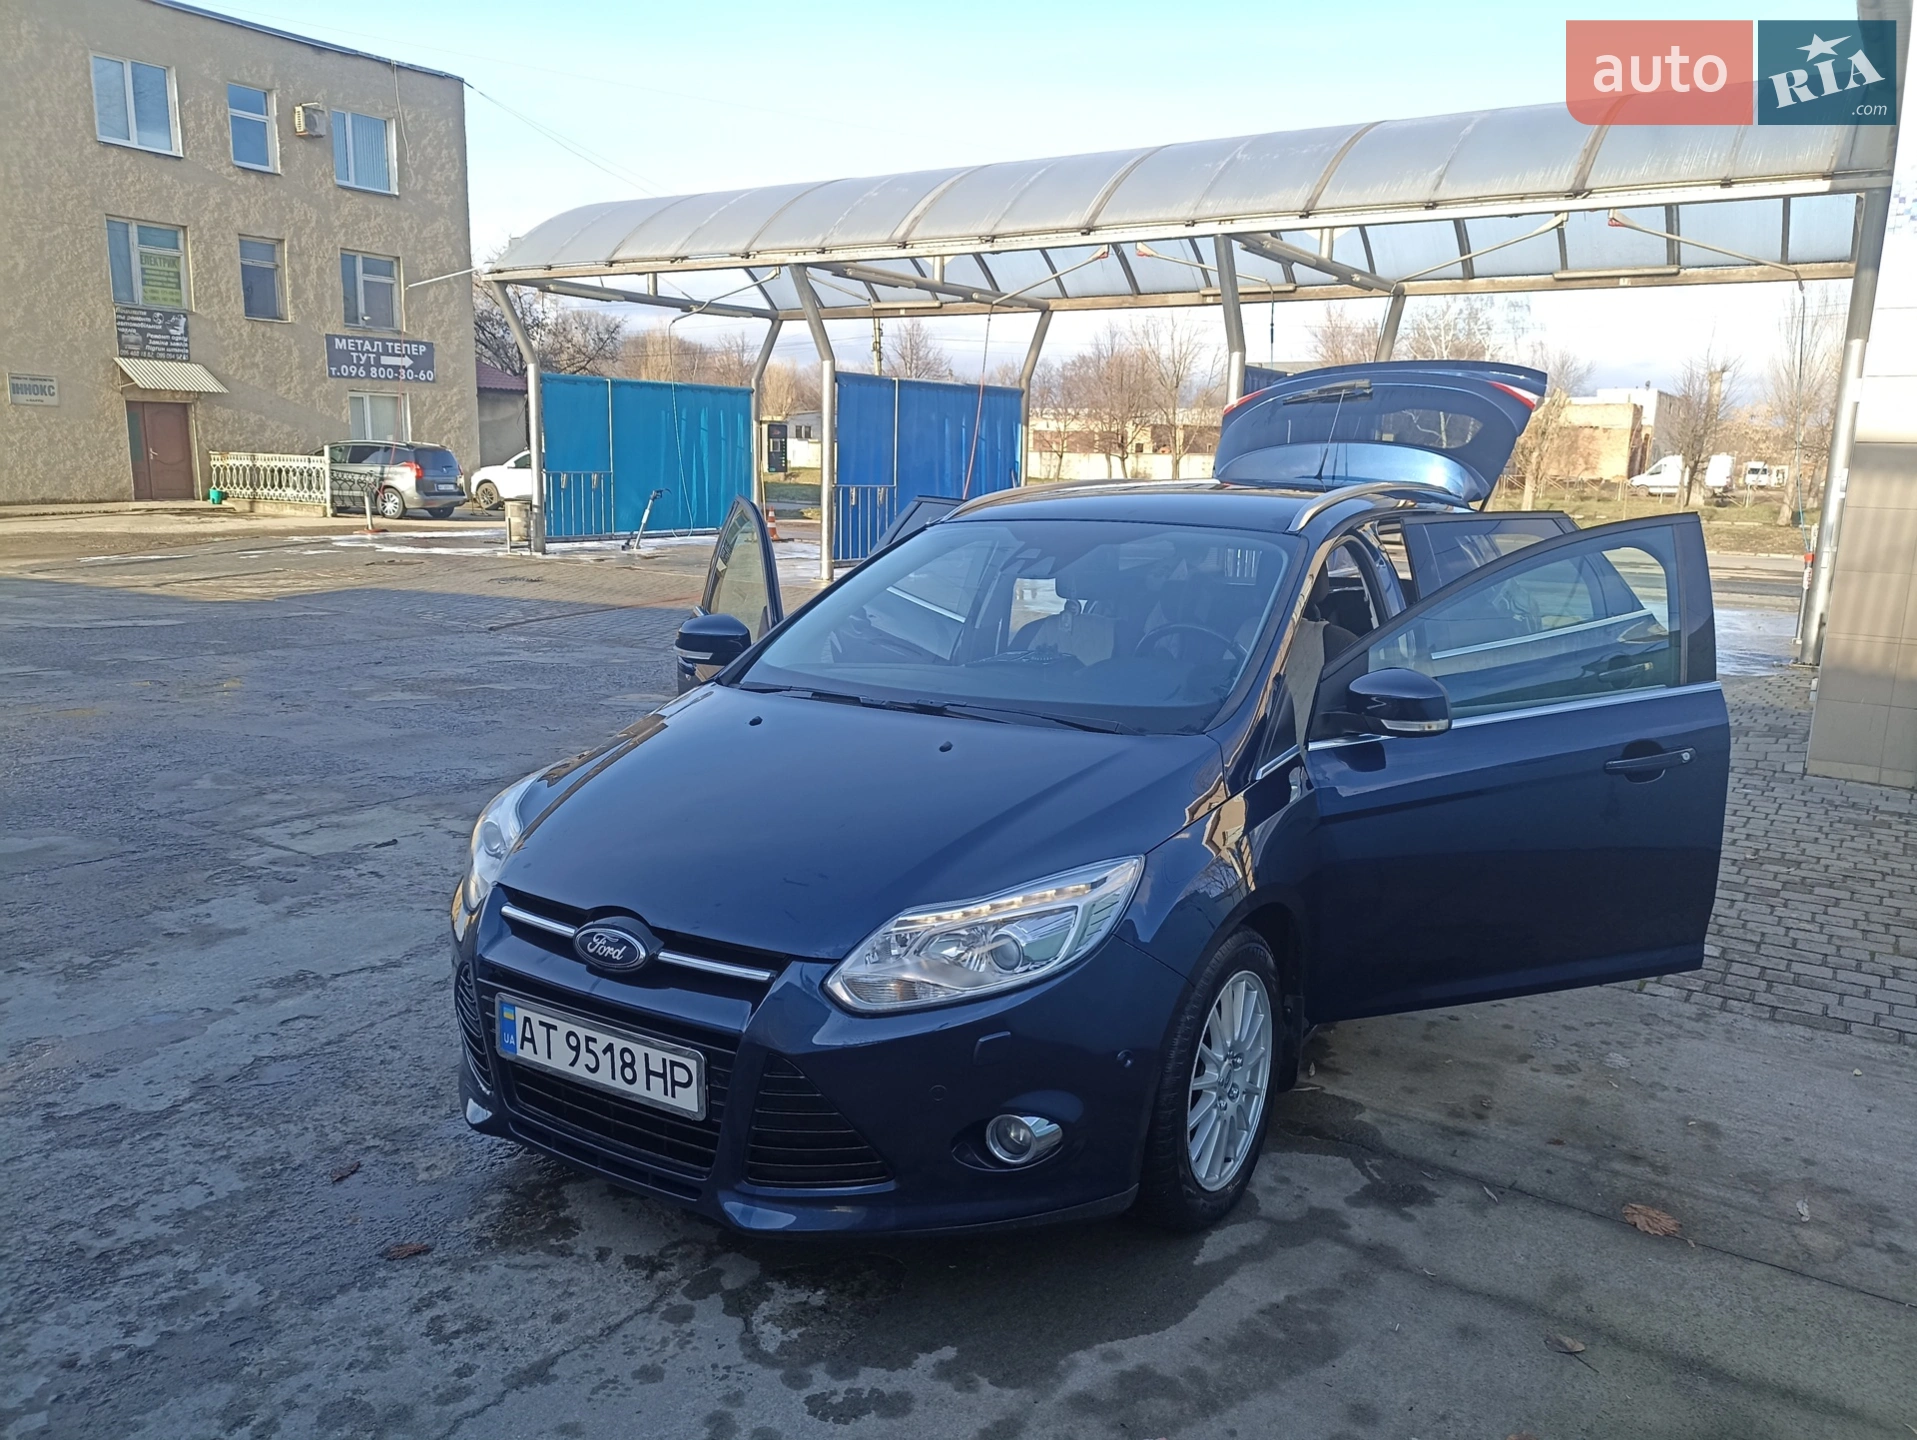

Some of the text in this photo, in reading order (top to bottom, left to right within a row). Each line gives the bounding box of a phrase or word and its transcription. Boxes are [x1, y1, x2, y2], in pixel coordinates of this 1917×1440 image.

[334, 337, 427, 356] МЕТАЛ ТЕПЕР
[350, 352, 376, 365] ТУТ
[330, 364, 434, 381] т.096 800-30-60
[11, 383, 56, 397] ІННОКС
[586, 932, 628, 962] Ford
[503, 1034, 516, 1046] UA
[519, 1016, 694, 1099] AT 9518 HP
